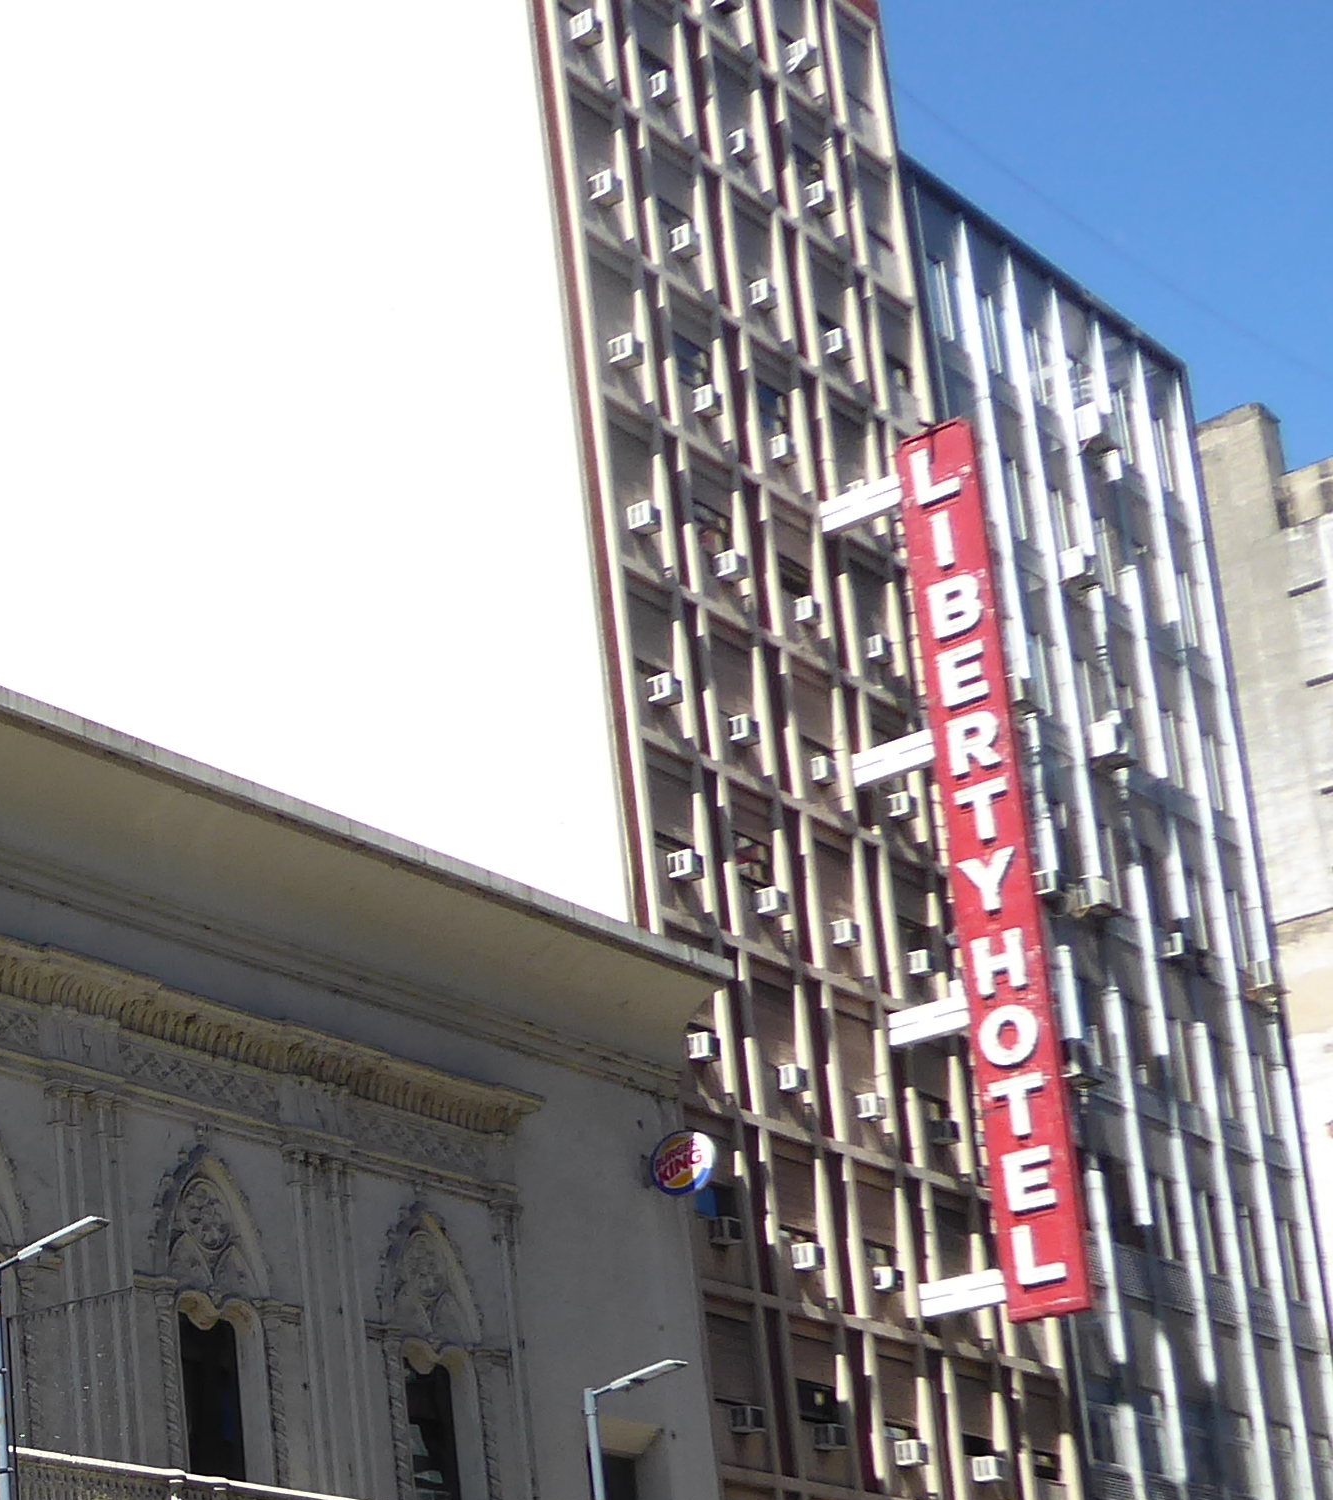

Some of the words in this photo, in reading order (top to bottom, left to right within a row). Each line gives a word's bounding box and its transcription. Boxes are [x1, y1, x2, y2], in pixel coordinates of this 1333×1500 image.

[911, 449, 1010, 914] LIBERTY
[970, 933, 1067, 1288] HOTEL
[658, 1149, 702, 1182] KING
